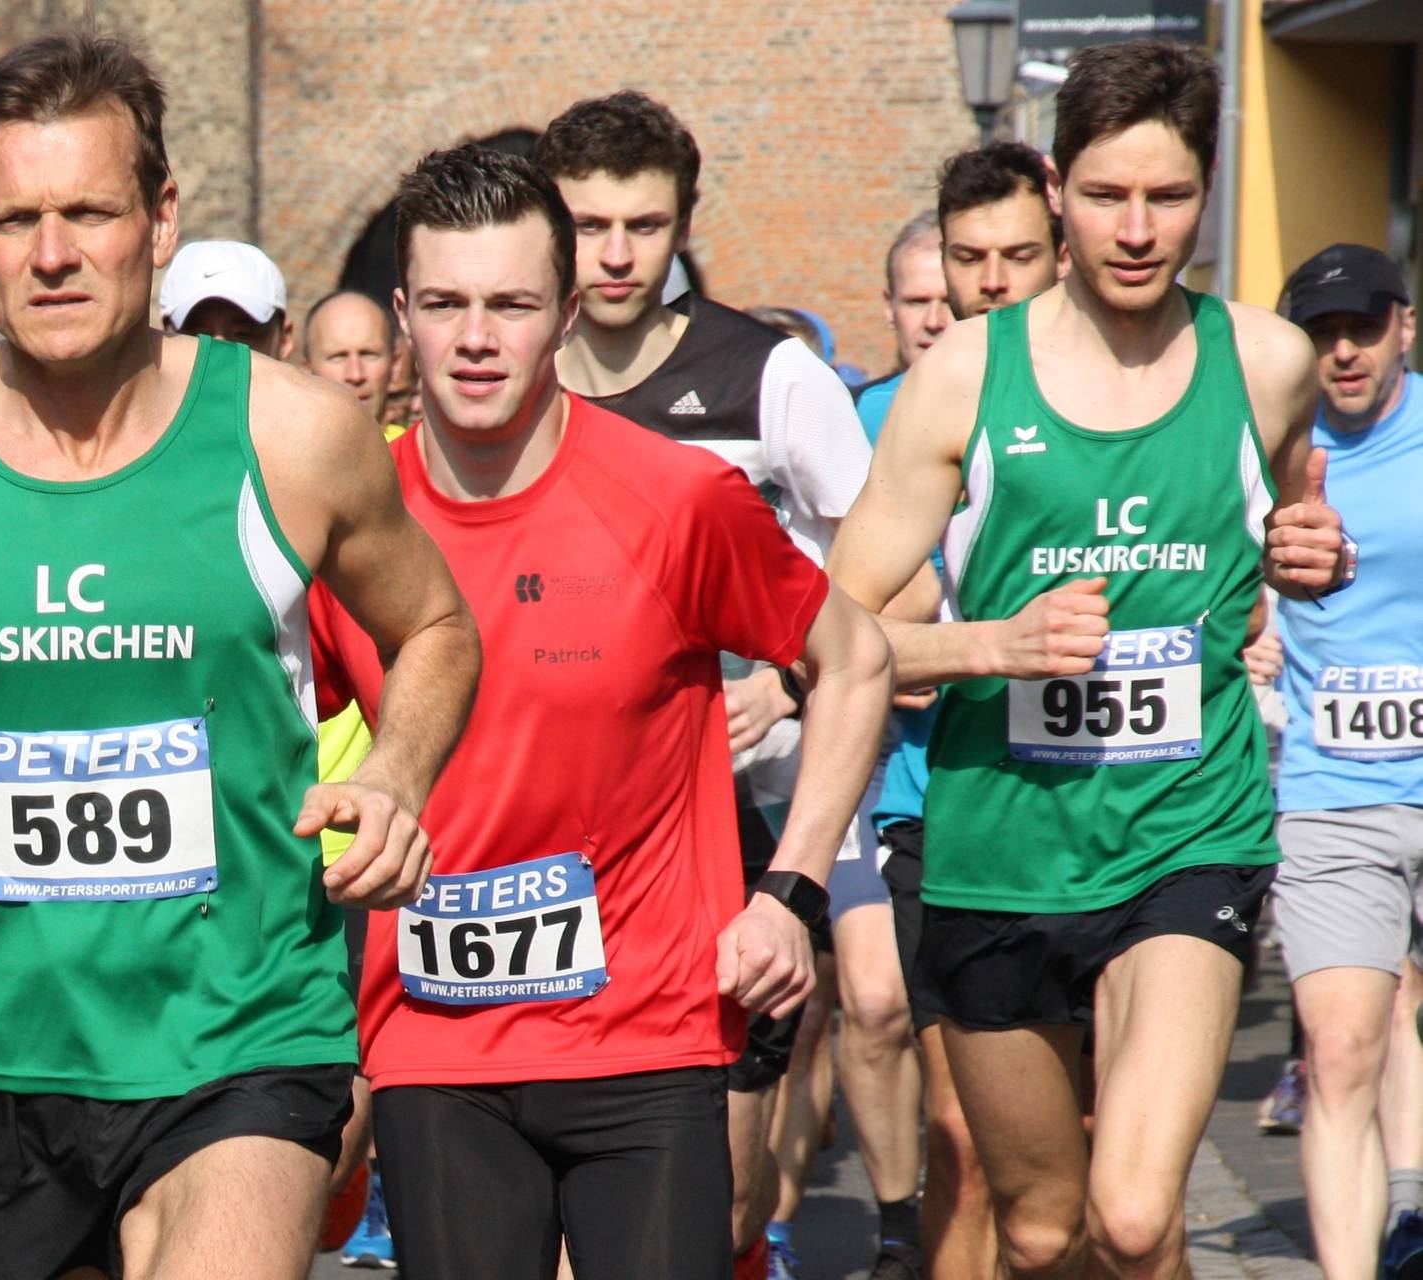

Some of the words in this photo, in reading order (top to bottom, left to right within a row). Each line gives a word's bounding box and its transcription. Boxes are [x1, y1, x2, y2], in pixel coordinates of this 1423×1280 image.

[1096, 496, 1149, 537] LC
[1032, 543, 1207, 576] EUSKIRCHEN
[36, 564, 106, 614] LC
[534, 646, 602, 664] Patrick
[1103, 628, 1195, 666] ERS
[1321, 664, 1423, 690] PETER
[1042, 678, 1168, 738] 955
[1032, 745, 1184, 762] WWW.PETERSSPORTTEAM.DE
[11, 788, 173, 867] 589
[3, 877, 197, 897] WWW.PETERSSPORTTEAM.DE
[416, 865, 568, 913] PETERS
[409, 905, 583, 980] 1677
[420, 976, 584, 998] WWW.PETERSSPORTTEAM.DE
